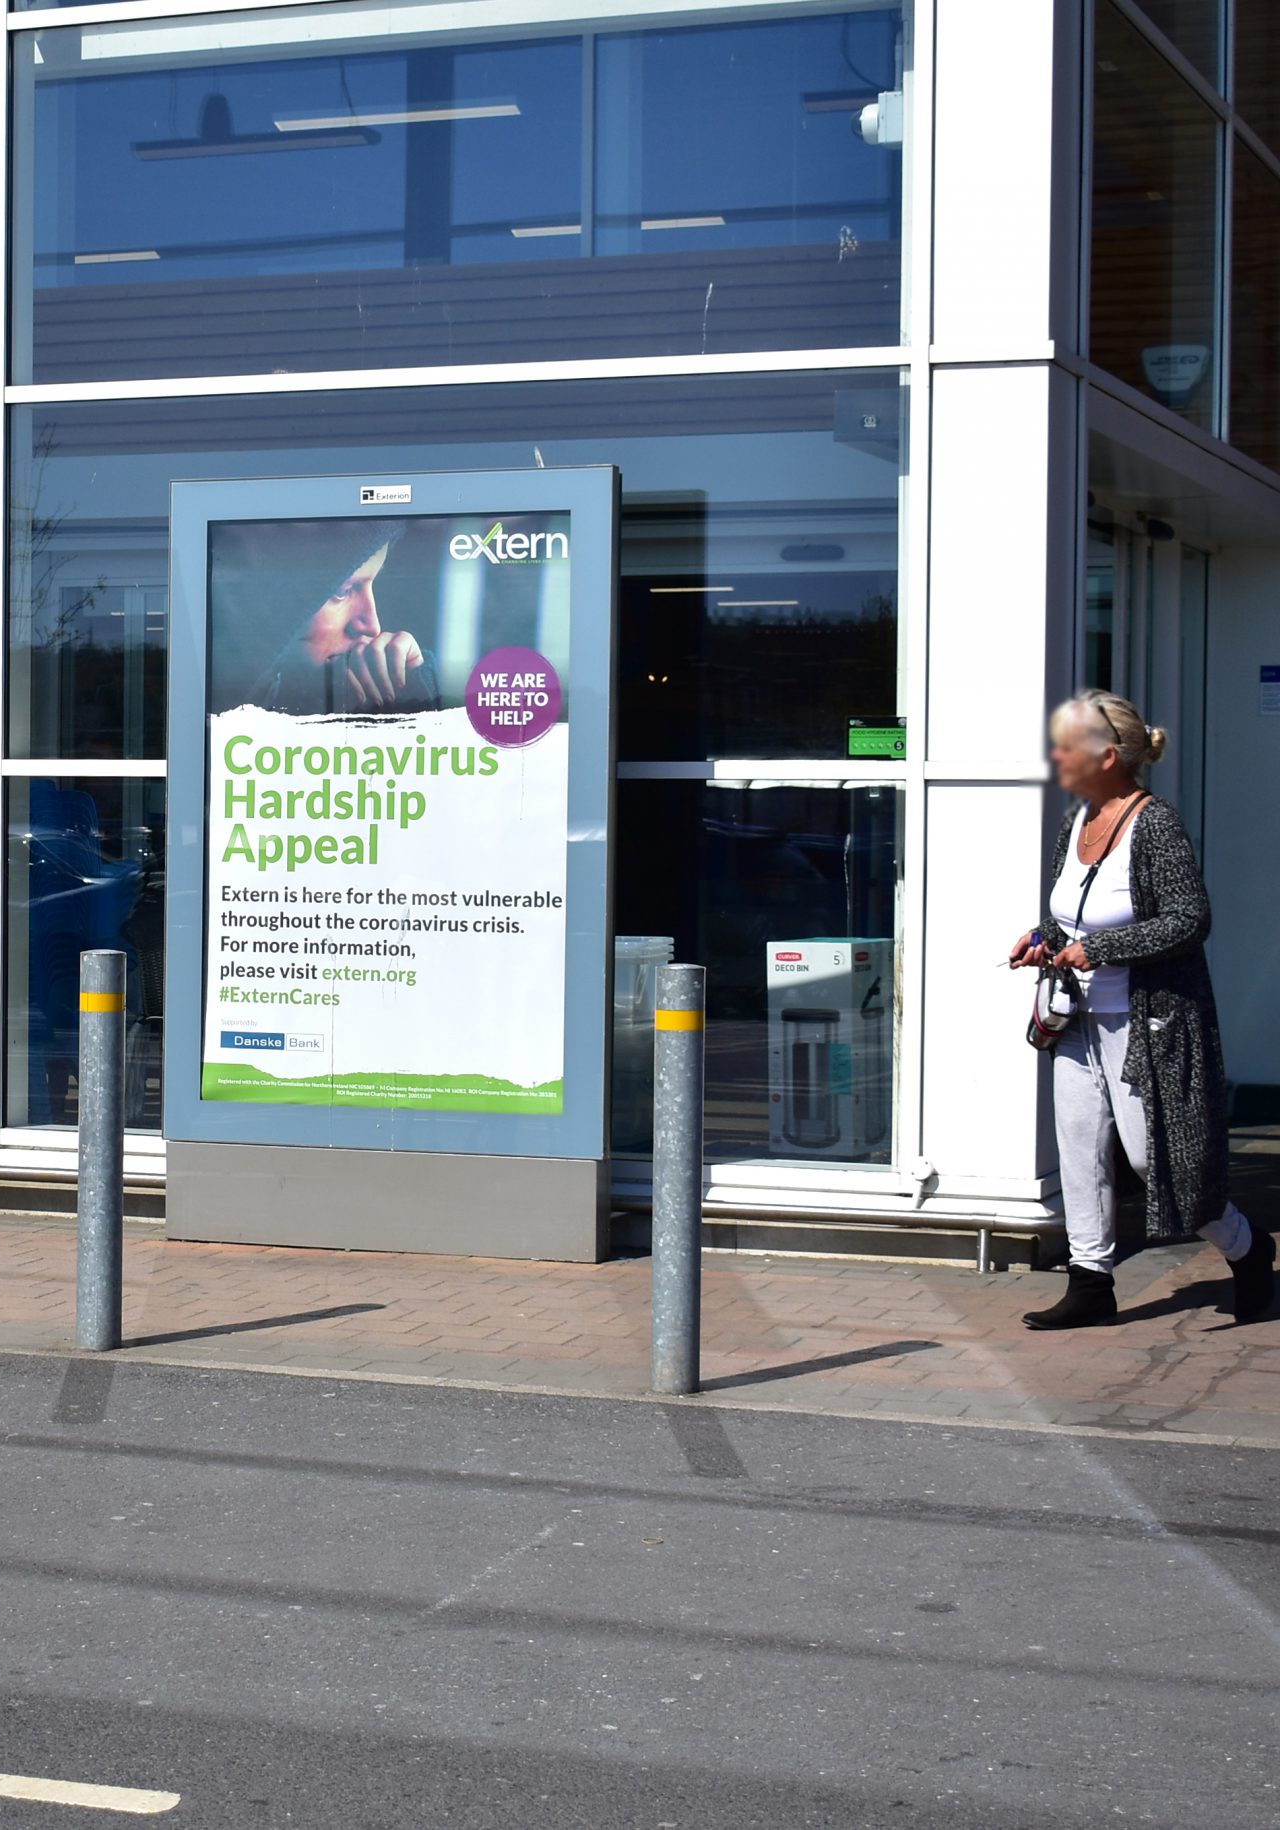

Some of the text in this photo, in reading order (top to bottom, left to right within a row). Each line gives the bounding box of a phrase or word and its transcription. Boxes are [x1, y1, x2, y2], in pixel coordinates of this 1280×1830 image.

[376, 492, 410, 501] Exterion
[449, 522, 568, 564] extern
[480, 672, 546, 688] WE ARE
[477, 691, 549, 707] HERE TO
[490, 710, 535, 726] HELP
[895, 741, 903, 751] 5
[224, 735, 499, 776] Coronavirus
[224, 779, 426, 829] Hardship
[221, 823, 379, 872] Appeal
[221, 886, 563, 908] Extern is here for the most vulnerable
[220, 911, 525, 934] throughout the coronavirus crisis.
[220, 936, 416, 960] For more information,
[775, 964, 809, 972] DECO BIN
[833, 955, 841, 966] 5
[220, 962, 417, 986] please visit extern.org
[219, 986, 340, 1006] #ExternCares
[221, 1018, 258, 1028] Supported by
[234, 1035, 320, 1048] Danske Bank
